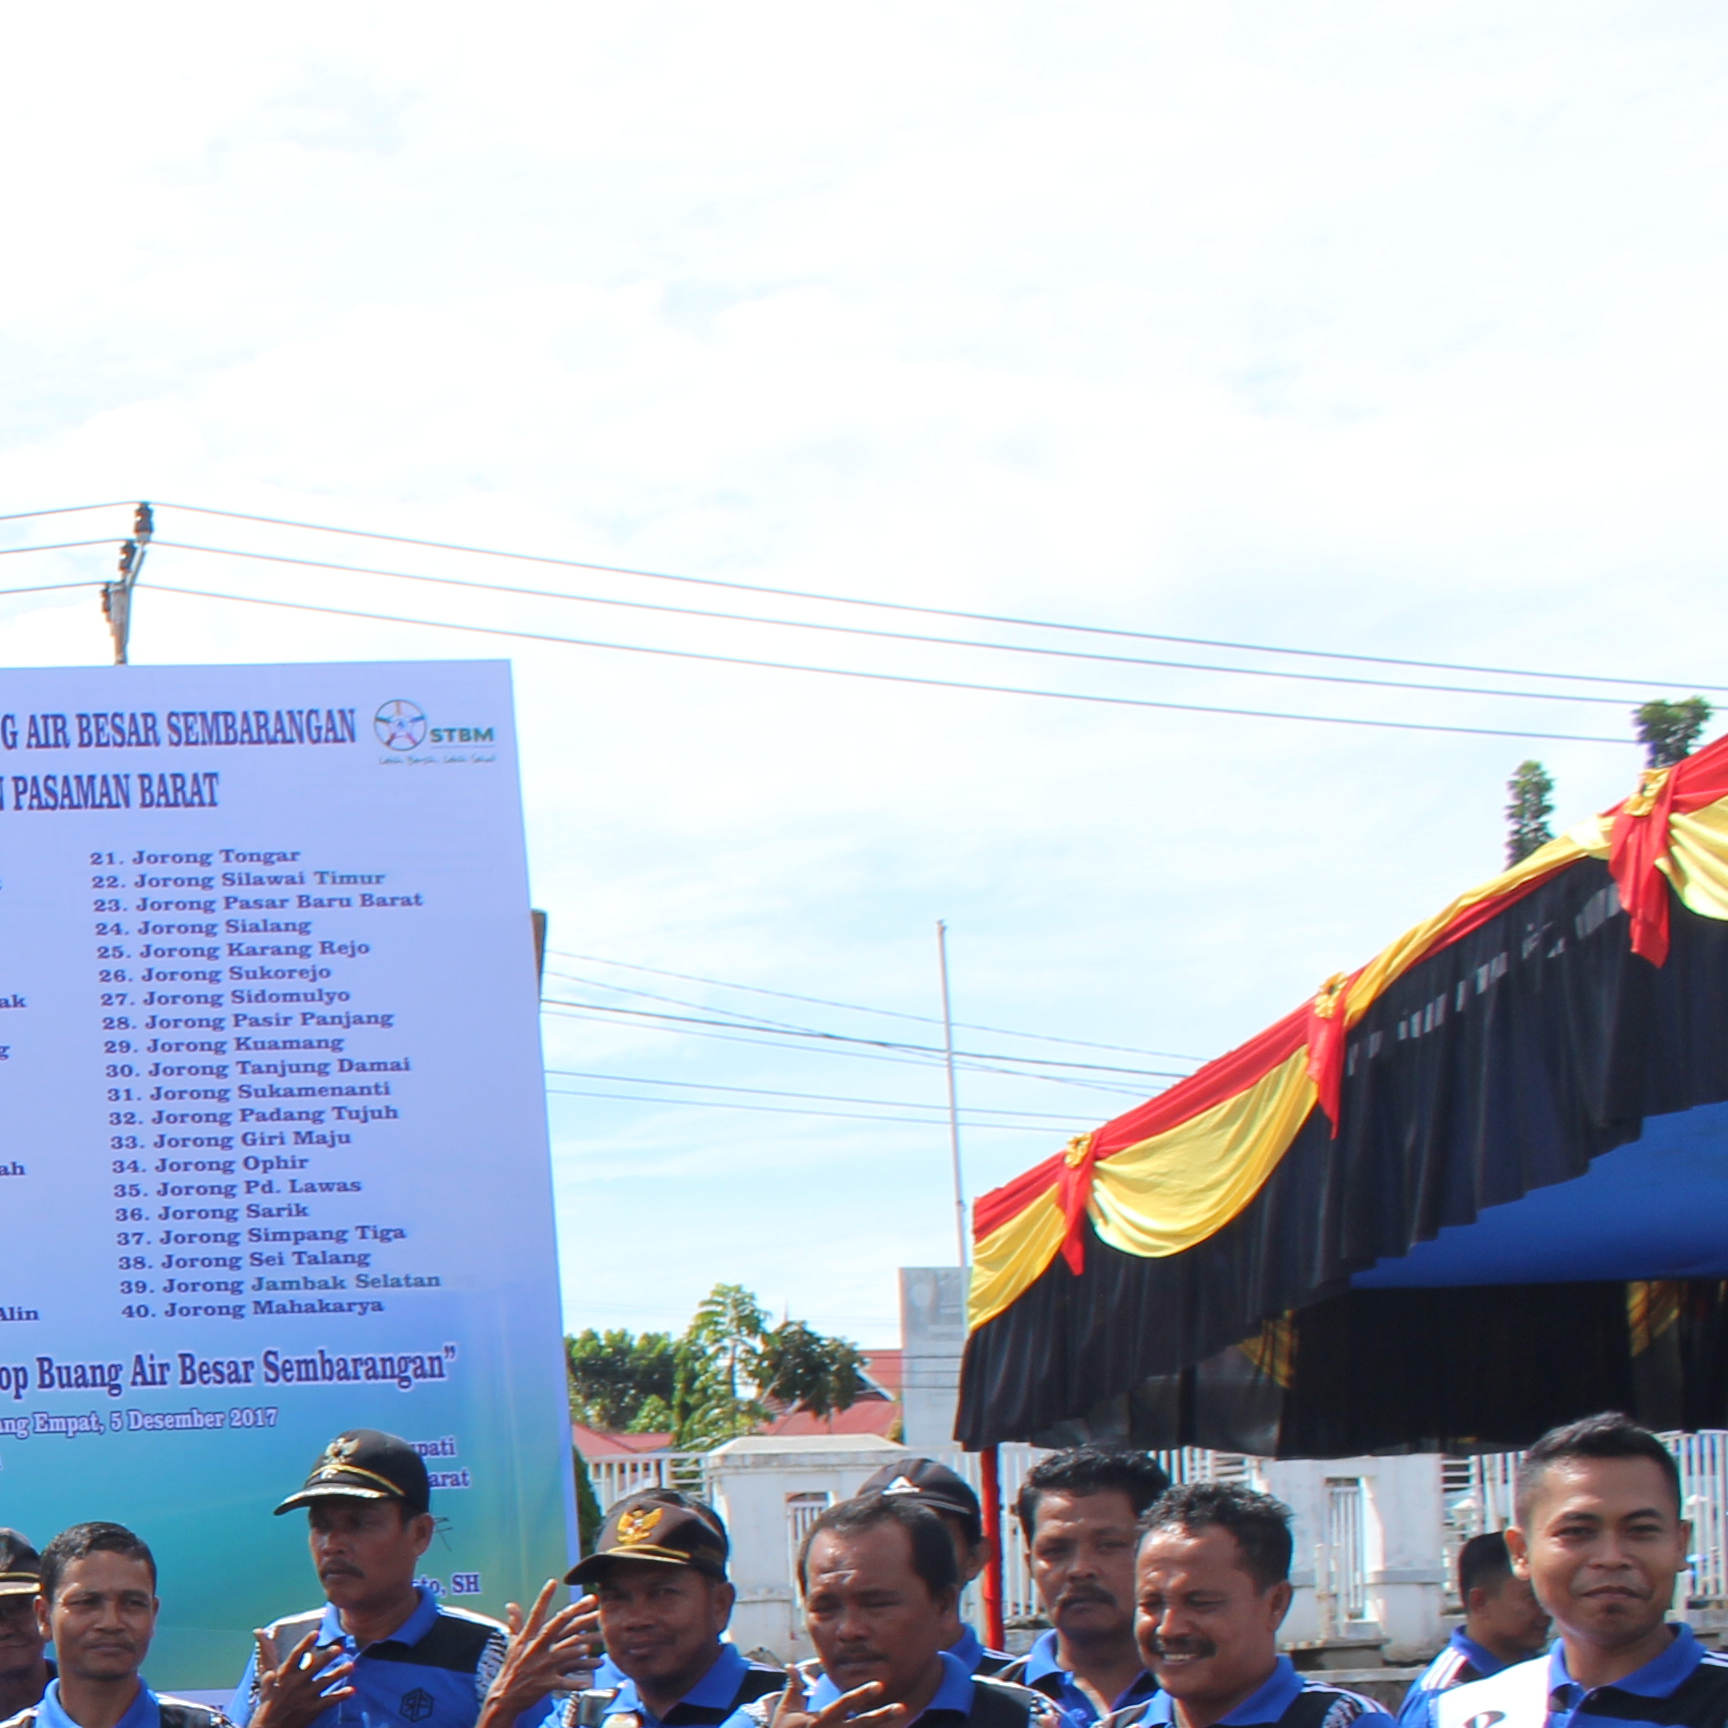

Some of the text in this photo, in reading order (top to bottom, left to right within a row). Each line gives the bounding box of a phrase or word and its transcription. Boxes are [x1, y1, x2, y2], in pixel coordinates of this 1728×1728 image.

[25, 712, 70, 749] AIR
[78, 711, 160, 748] BESAR
[166, 709, 356, 747] SEMBARANGAN
[430, 728, 495, 745] STBM
[13, 773, 131, 812] PASAMAN
[139, 771, 219, 809] BARAT
[101, 988, 351, 1008] 27. Jorong Sidomulyo
[120, 1274, 441, 1295] 39. Jorong Jambak Selatan
[37, 1356, 123, 1397] Buang
[130, 1353, 170, 1386] Air
[179, 1350, 254, 1385] Besar
[33, 1410, 105, 1437] Empat,
[110, 1410, 122, 1430] 5
[127, 1409, 225, 1431] Desember
[230, 1407, 279, 1428] 2017
[451, 1573, 482, 1595] SH
